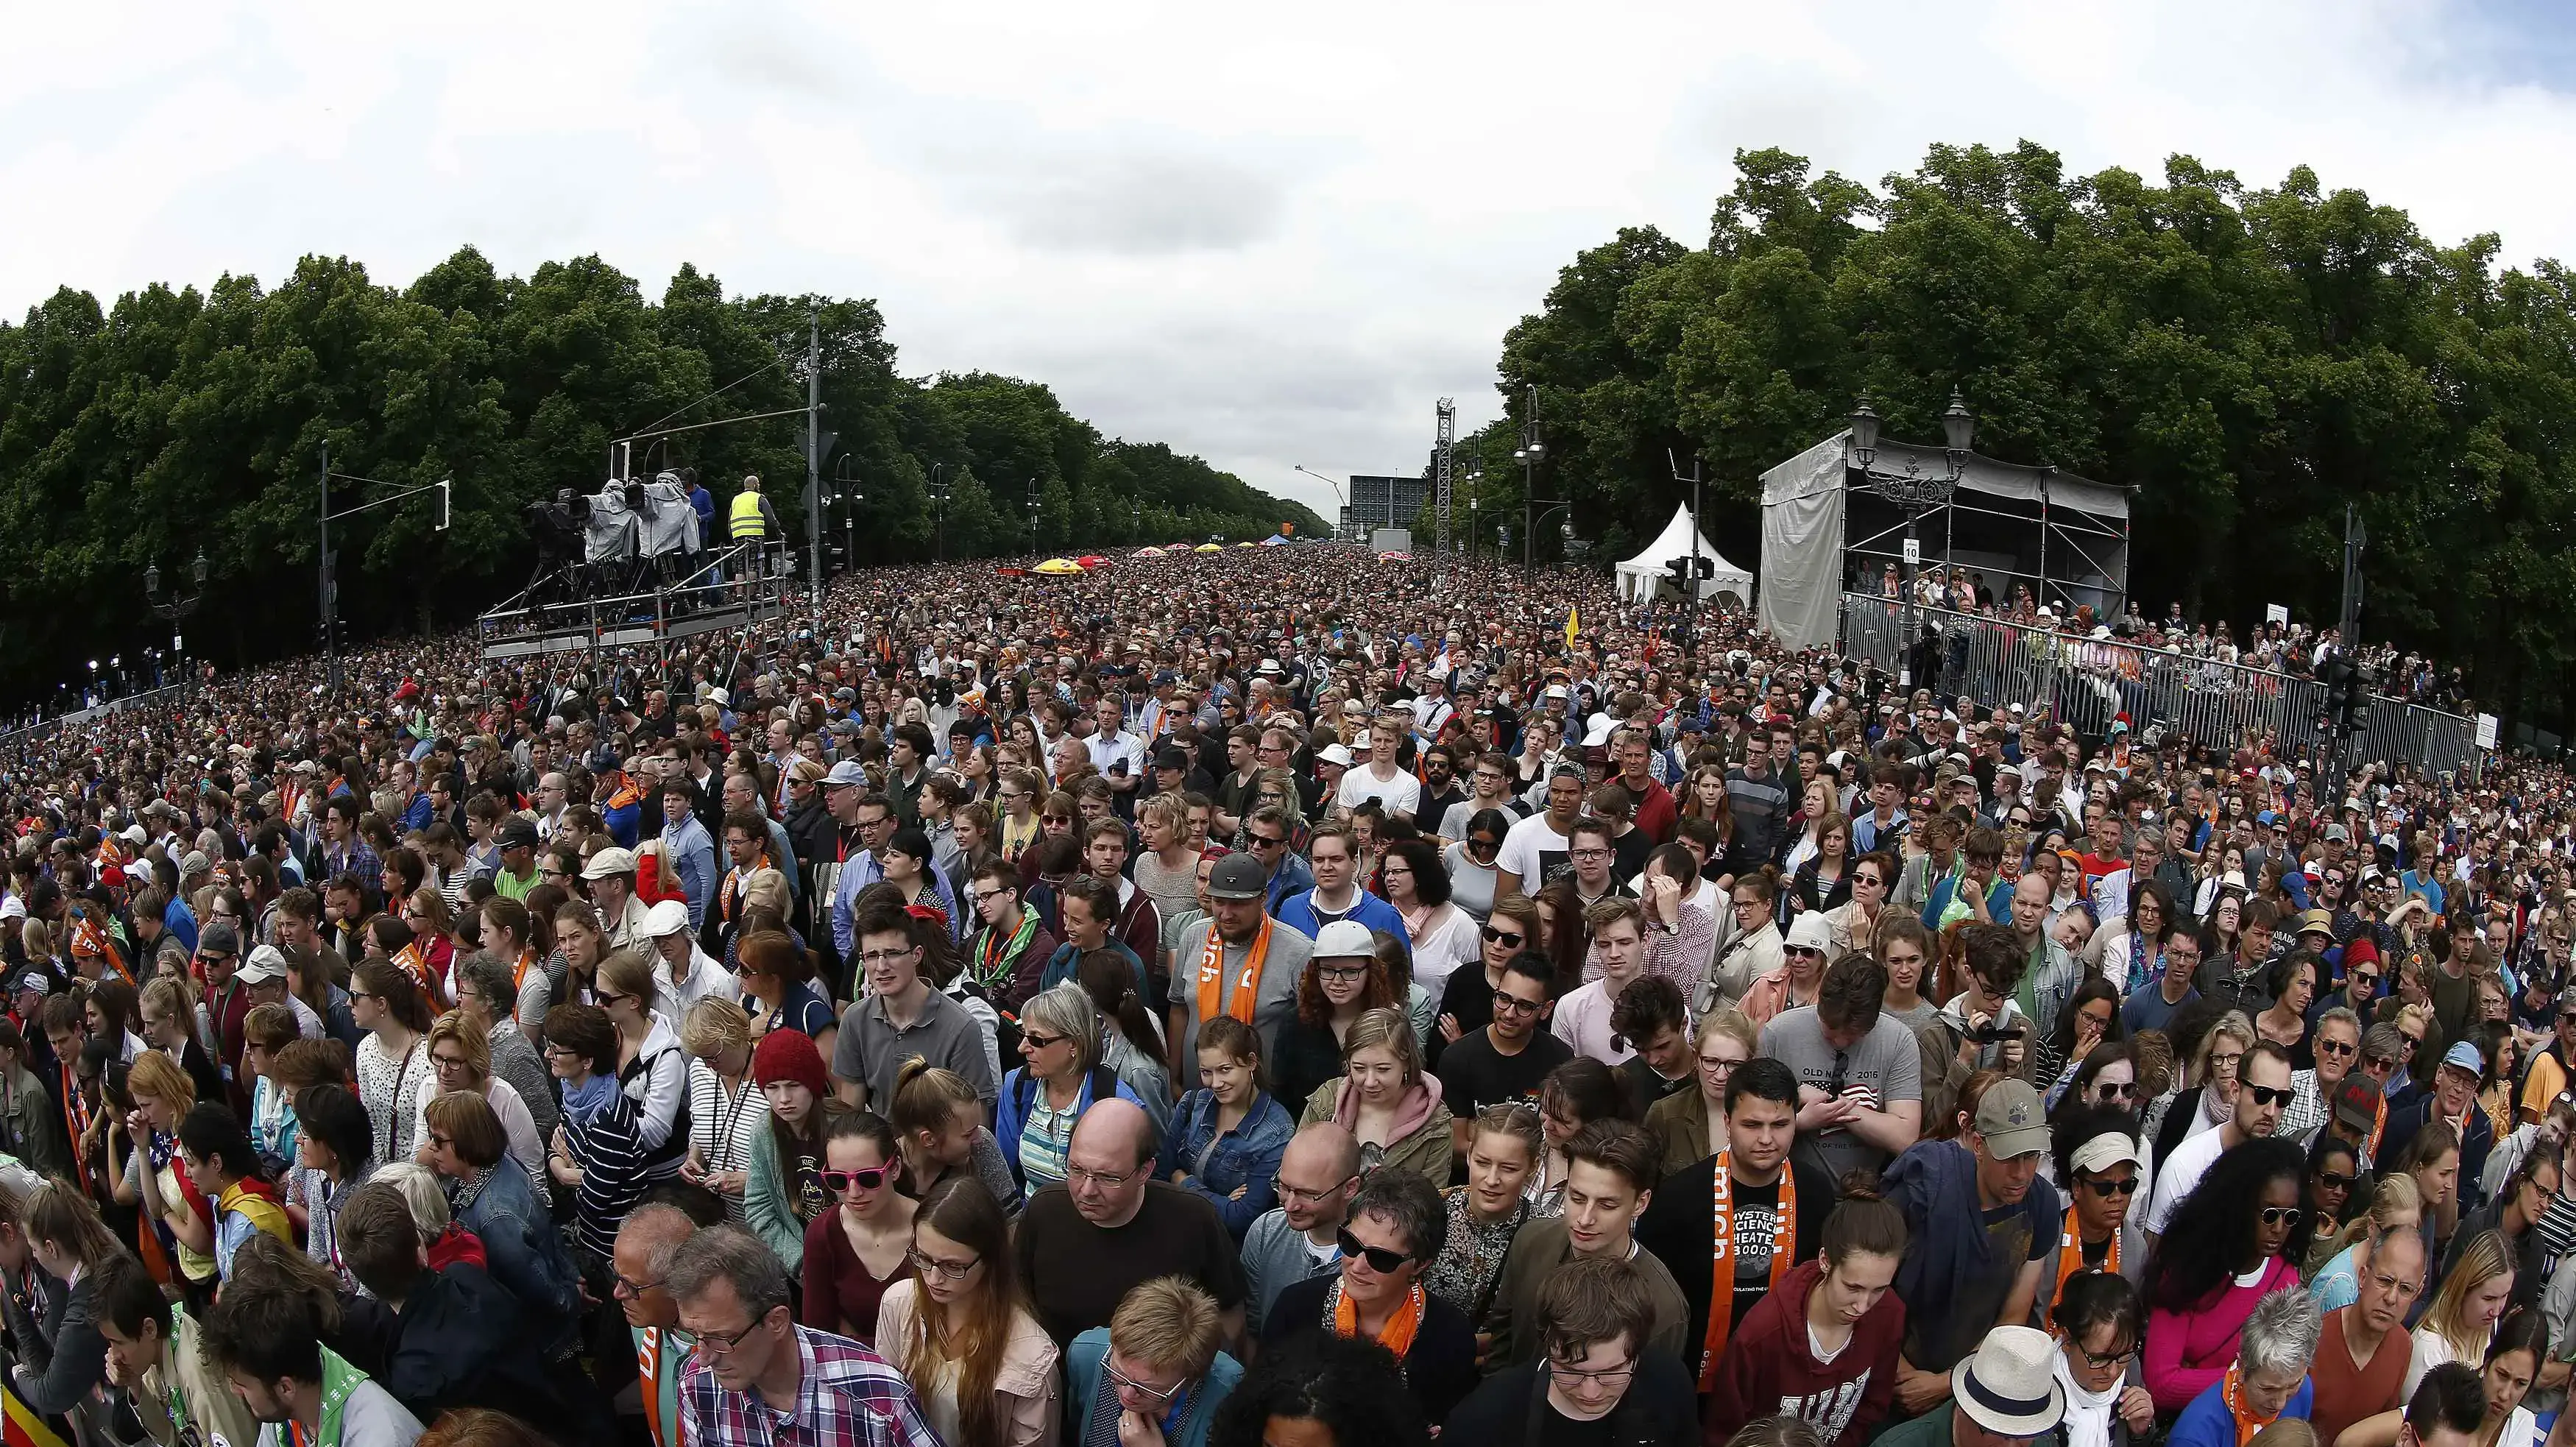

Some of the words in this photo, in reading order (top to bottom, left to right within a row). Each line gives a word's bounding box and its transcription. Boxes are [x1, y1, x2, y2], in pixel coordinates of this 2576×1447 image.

[1905, 548, 1917, 557] 10
[1802, 1067, 1823, 1077] OLD
[1857, 1070, 1878, 1079] 2016
[1713, 1166, 1729, 1259] mich
[1733, 1220, 1777, 1234] CIENC
[1733, 1244, 1768, 1256] 3000
